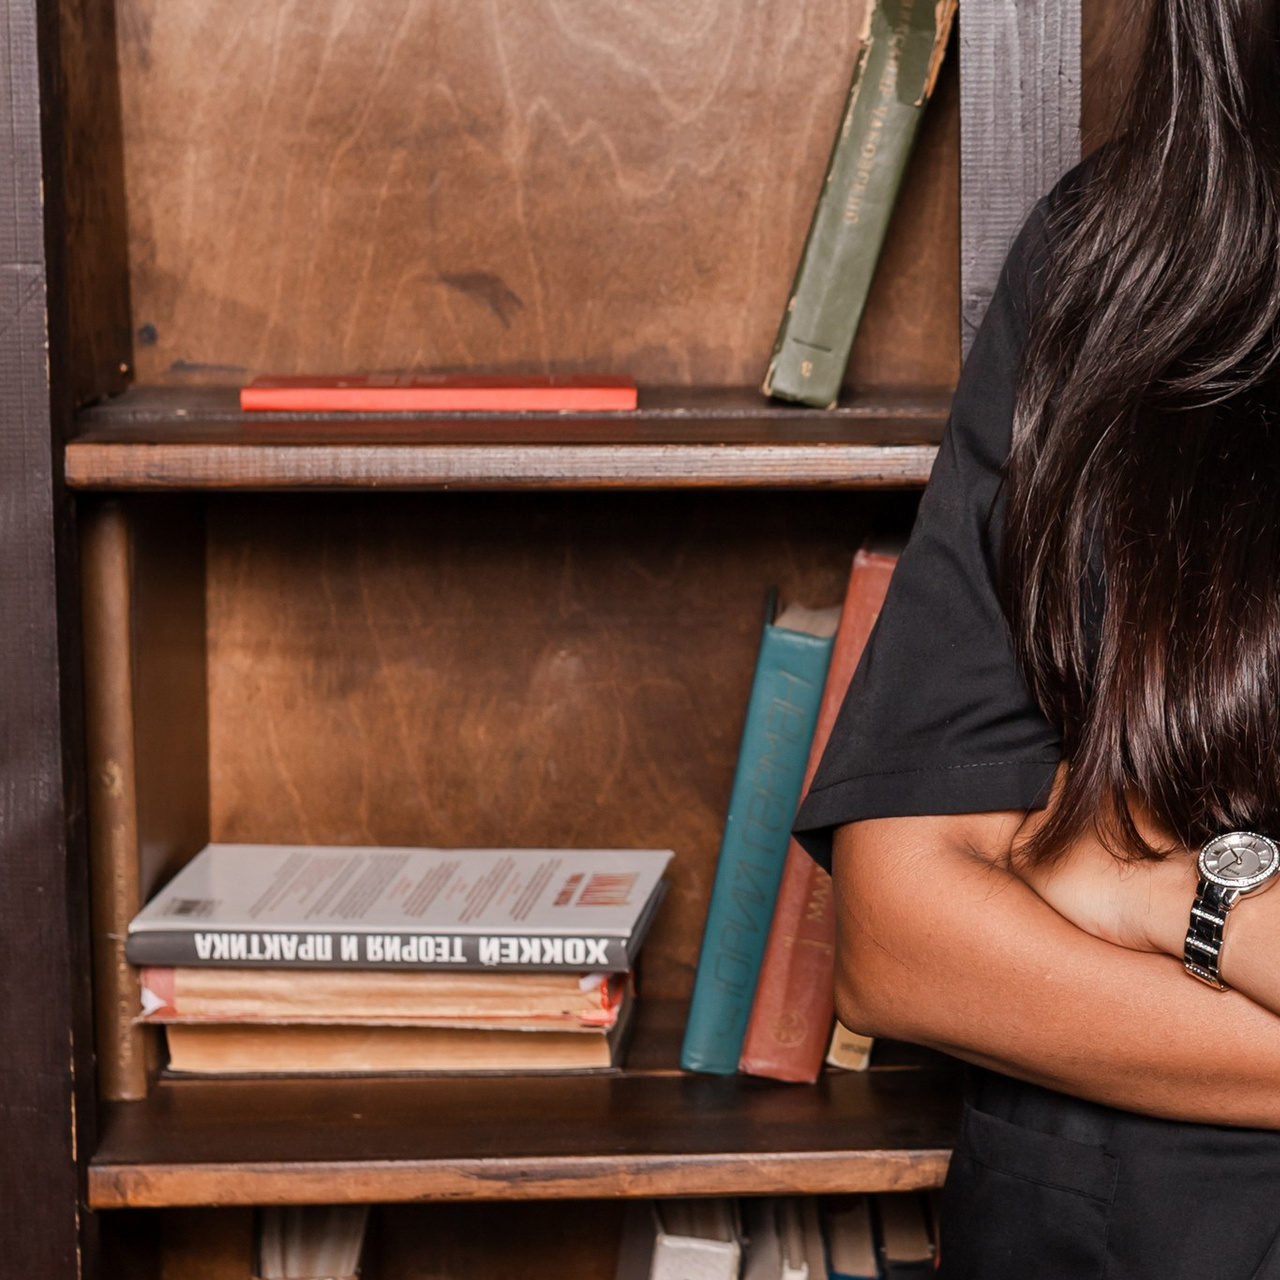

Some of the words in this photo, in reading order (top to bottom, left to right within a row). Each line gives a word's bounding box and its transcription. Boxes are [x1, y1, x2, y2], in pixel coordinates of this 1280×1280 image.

[194, 932, 334, 962] ПРАКТИКА
[340, 935, 359, 962] И
[366, 935, 466, 964] ТЕОРИЯ
[478, 936, 610, 967] ХОККЕЙ
